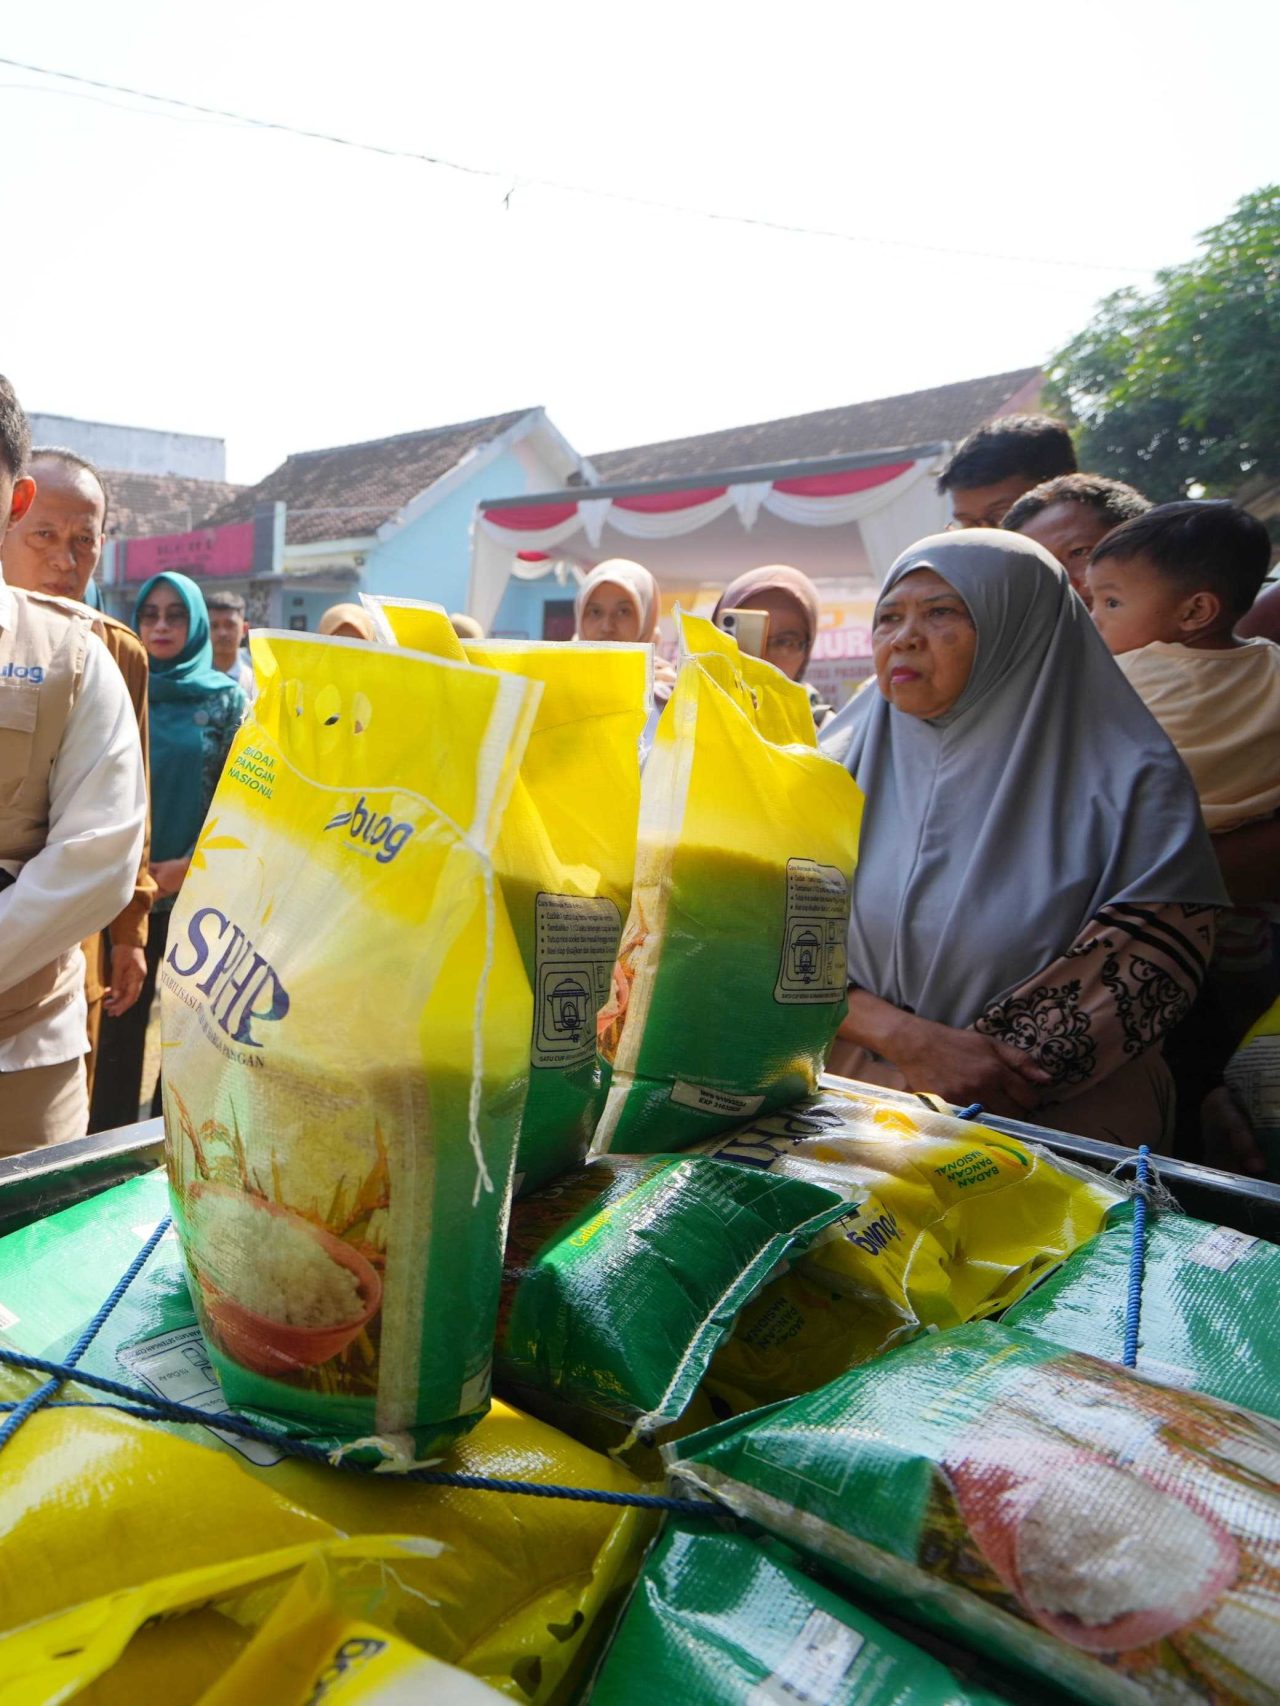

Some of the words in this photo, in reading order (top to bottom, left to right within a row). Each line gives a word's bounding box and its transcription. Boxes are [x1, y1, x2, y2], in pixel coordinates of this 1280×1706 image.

[228, 767, 273, 800] NASIONAL
[234, 756, 276, 784] PANGAN
[934, 1150, 984, 1177] NASIONAL
[947, 1156, 993, 1183] PANGAN
[957, 1167, 1000, 1189] BADAN
[744, 1296, 788, 1344] NASIONA
